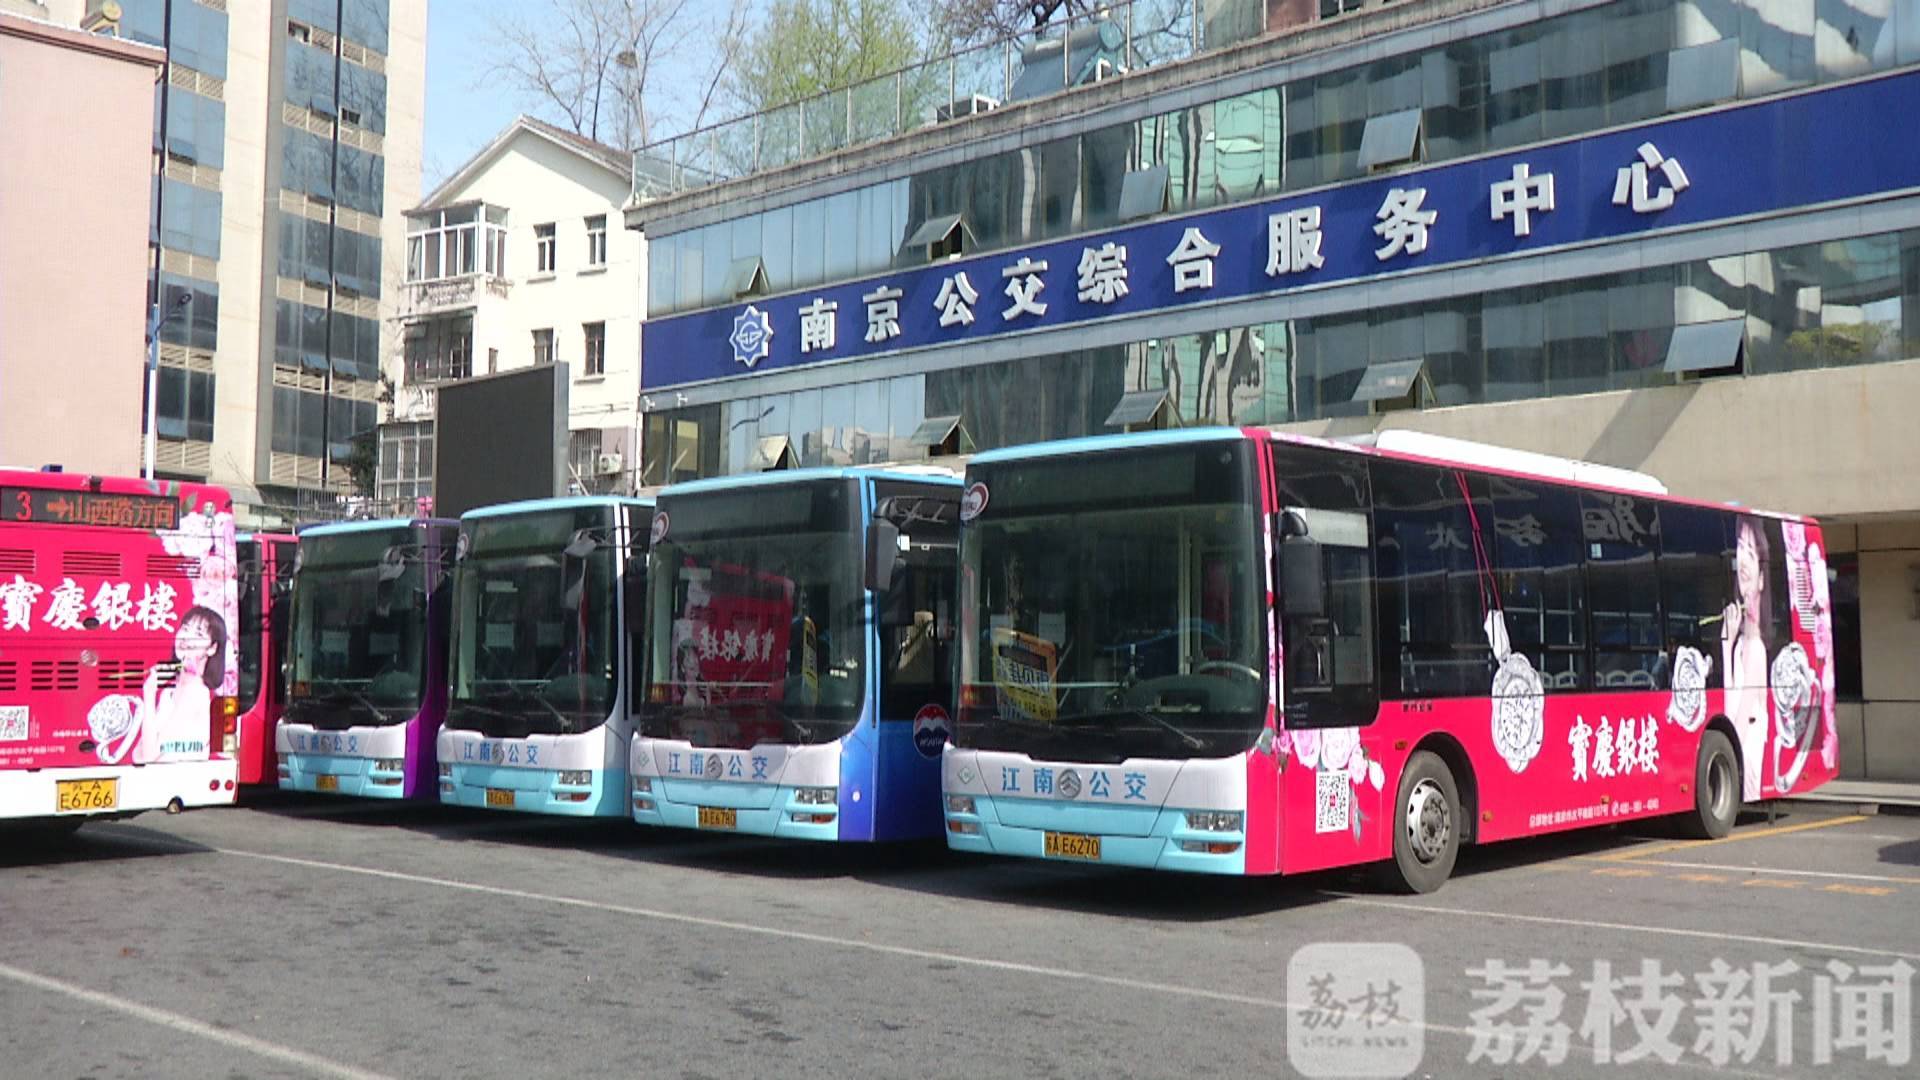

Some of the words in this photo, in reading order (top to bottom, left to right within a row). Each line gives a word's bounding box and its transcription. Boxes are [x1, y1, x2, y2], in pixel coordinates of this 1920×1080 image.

[798, 140, 1691, 354] 南京公交综合服务中心
[15, 491, 32, 521] 3
[68, 495, 175, 528] 山西路方向
[668, 751, 769, 780] 江南公交
[60, 791, 113, 809] E6766
[1001, 766, 1147, 801] 江南公交
